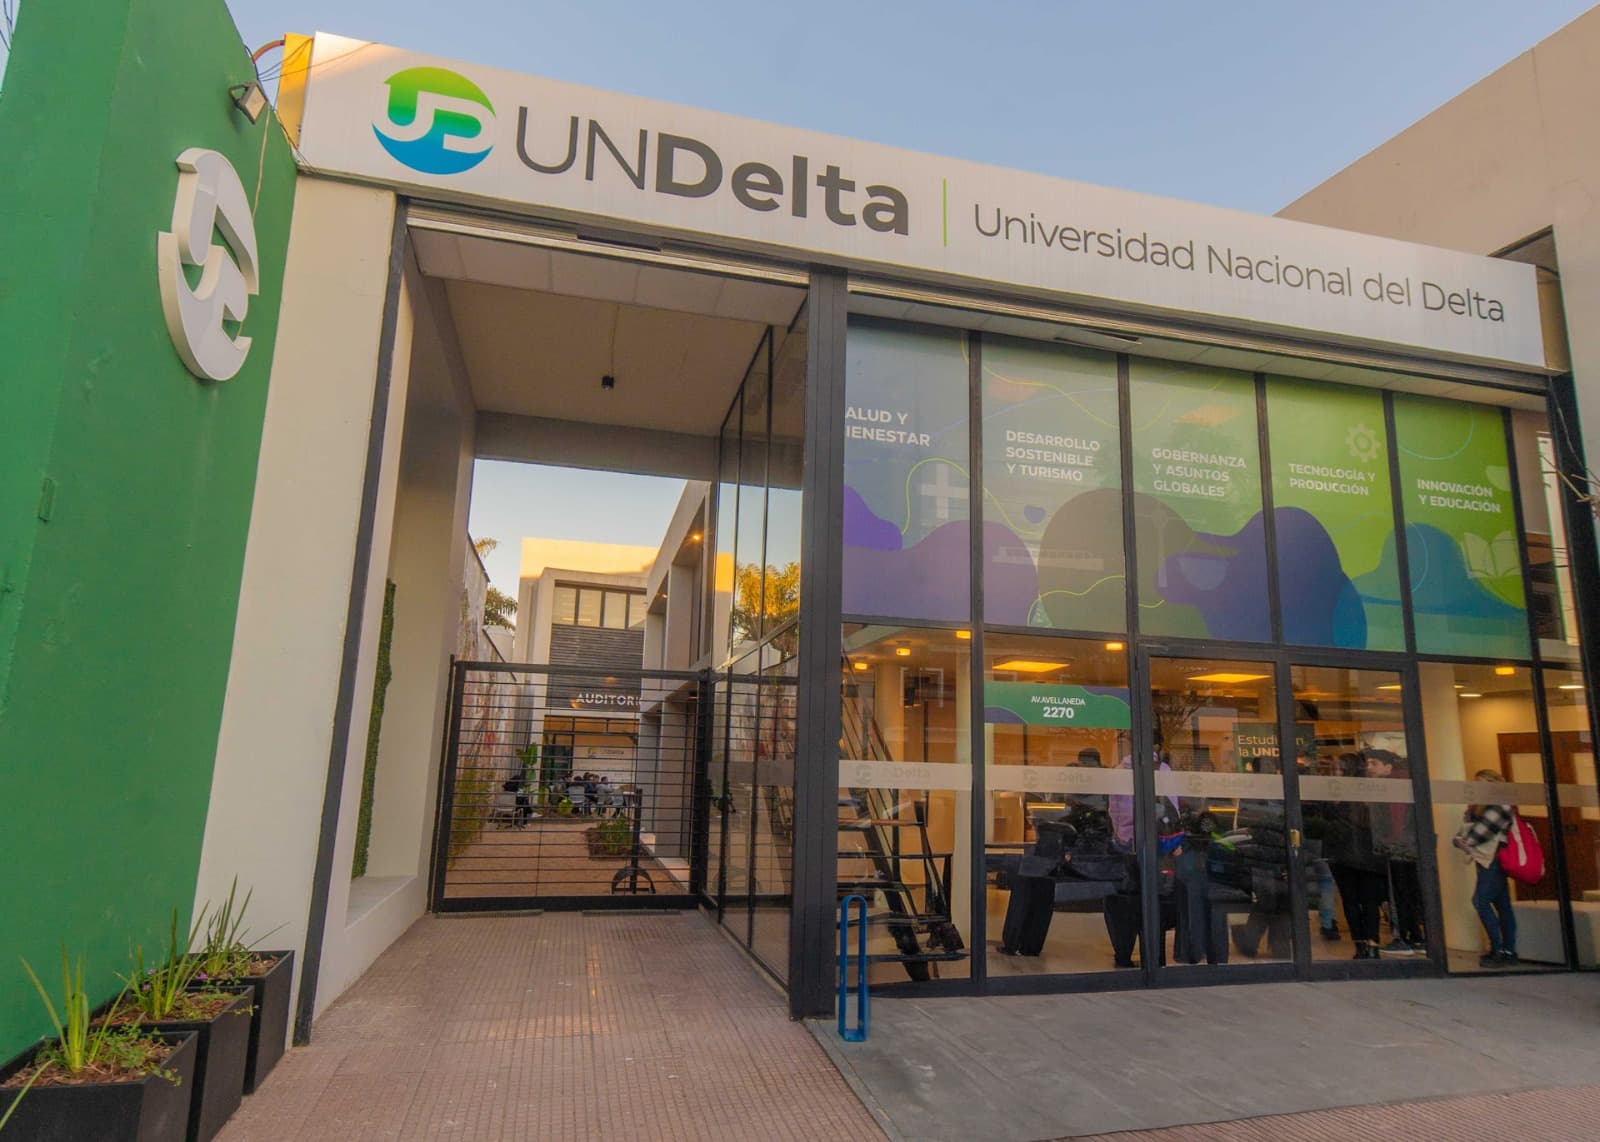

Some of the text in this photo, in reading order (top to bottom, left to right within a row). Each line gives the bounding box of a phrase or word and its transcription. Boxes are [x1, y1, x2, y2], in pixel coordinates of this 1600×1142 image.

[515, 105, 910, 236] UNDelta
[974, 203, 1505, 322] Universidad Nacional del Delta
[845, 406, 908, 425] ALUD Y
[846, 425, 930, 447] IENESTAR
[1006, 430, 1100, 451] DESARROLLO
[1006, 447, 1094, 467] SOSTENIBLE
[1152, 447, 1247, 469] GOBERNANZA
[1006, 463, 1083, 481] Y TURISMO
[1152, 464, 1230, 482] Y ASUNTOS
[1288, 463, 1376, 482] TECNOLOGÍA Y
[1153, 479, 1225, 497] GLOBALES
[1289, 477, 1369, 495] PRODUCCIÓN
[1416, 479, 1493, 497] INNOVACIÓN
[1417, 494, 1501, 513] Y EDUCACIÓN
[576, 692, 641, 706] AUDITORI
[1043, 706, 1075, 719] 2270
[1237, 734, 1278, 745] Estudi
[1239, 747, 1281, 757] la UND
